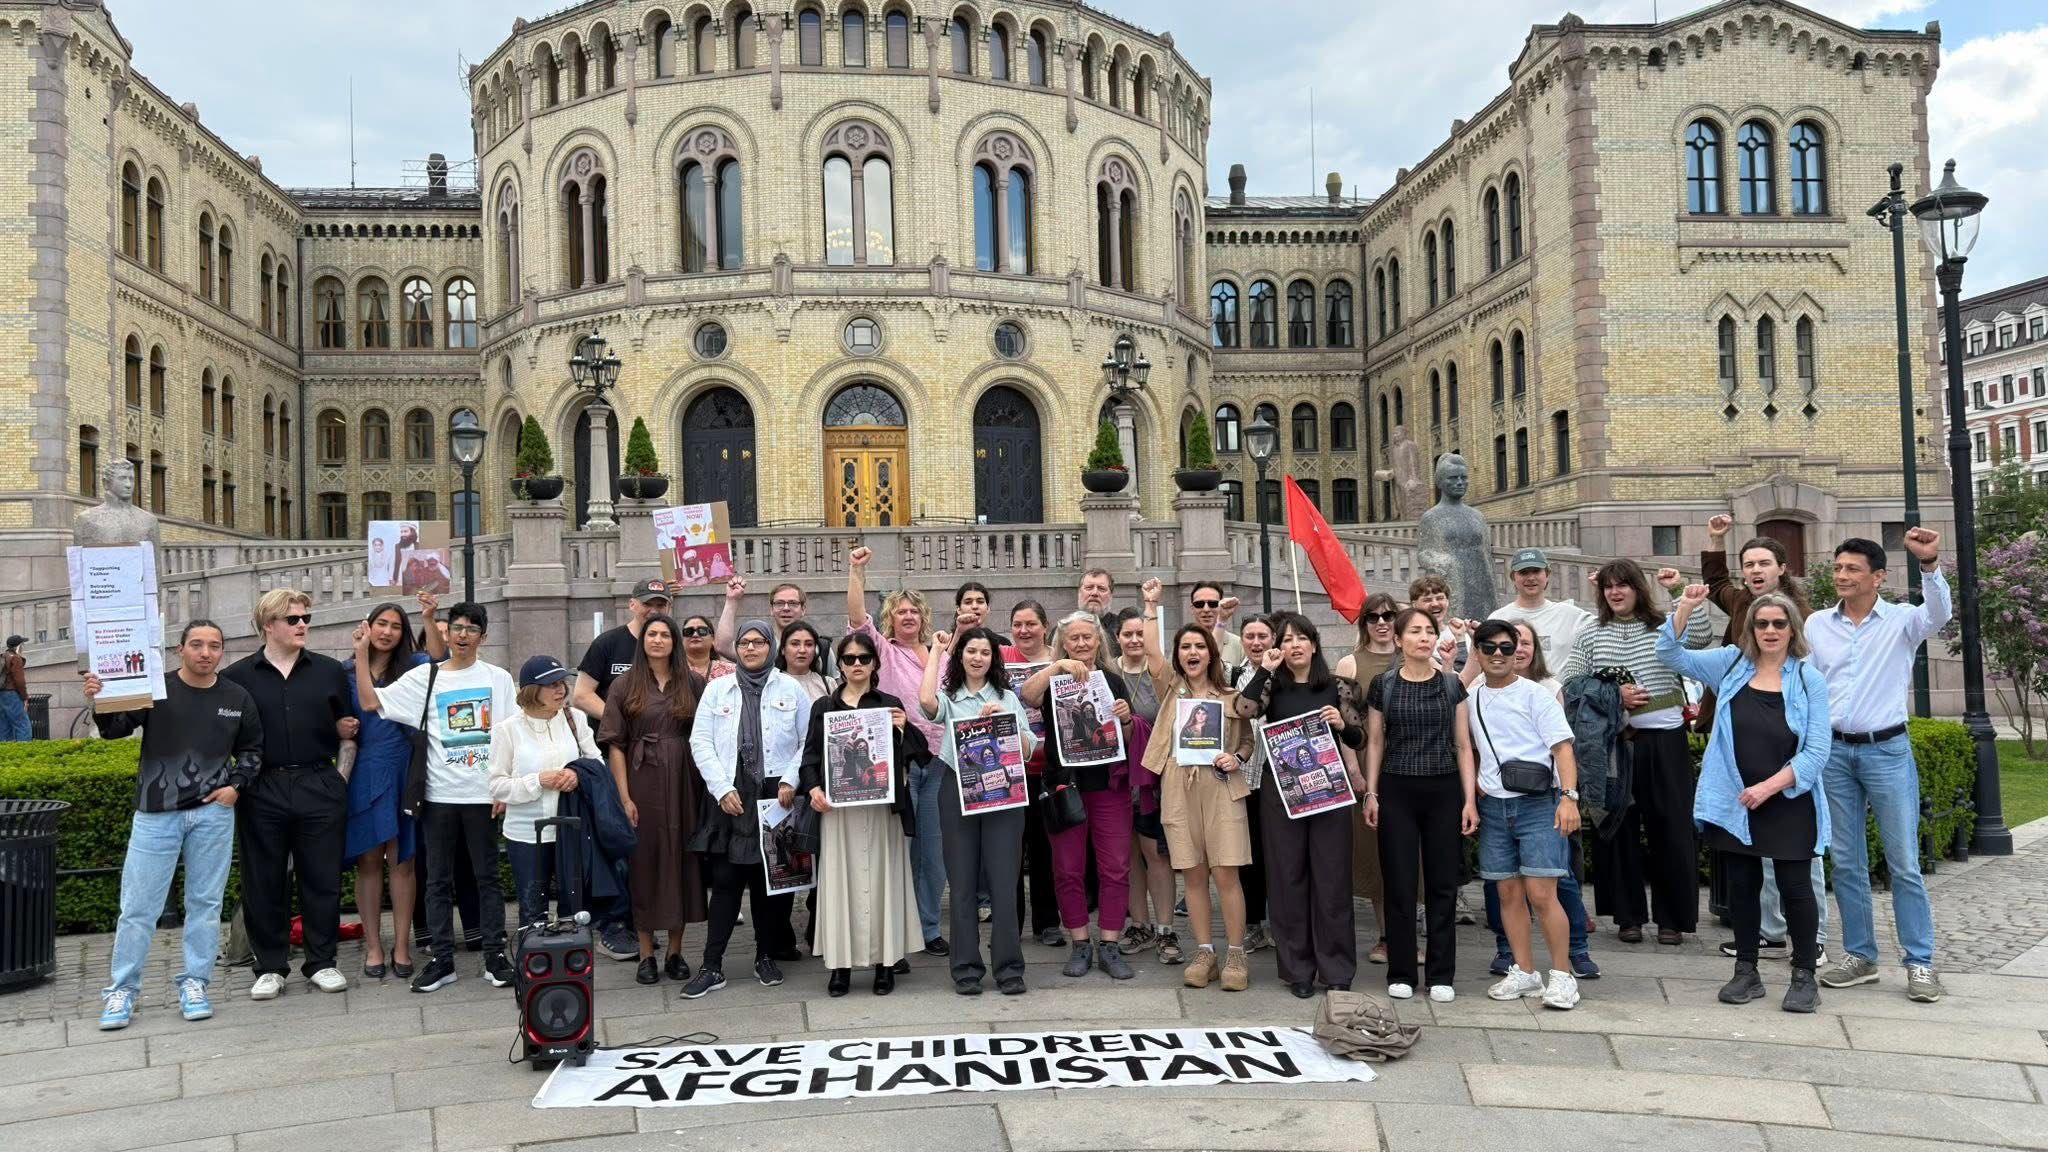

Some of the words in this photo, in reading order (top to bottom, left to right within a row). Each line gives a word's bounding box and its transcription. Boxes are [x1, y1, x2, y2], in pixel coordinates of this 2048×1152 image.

[829, 714, 856, 724] RADICAL
[830, 717, 863, 730] FEMINIST
[960, 727, 986, 740] مبارز
[1266, 722, 1291, 736] RADICAL
[1268, 725, 1304, 747] FEMINIST
[1311, 771, 1325, 780] GIRL
[615, 1045, 805, 1070] SAVE
[828, 1033, 1184, 1062] CHILDREN
[1208, 1031, 1283, 1048] IN
[594, 1052, 1302, 1101] AFGHANISTAN
